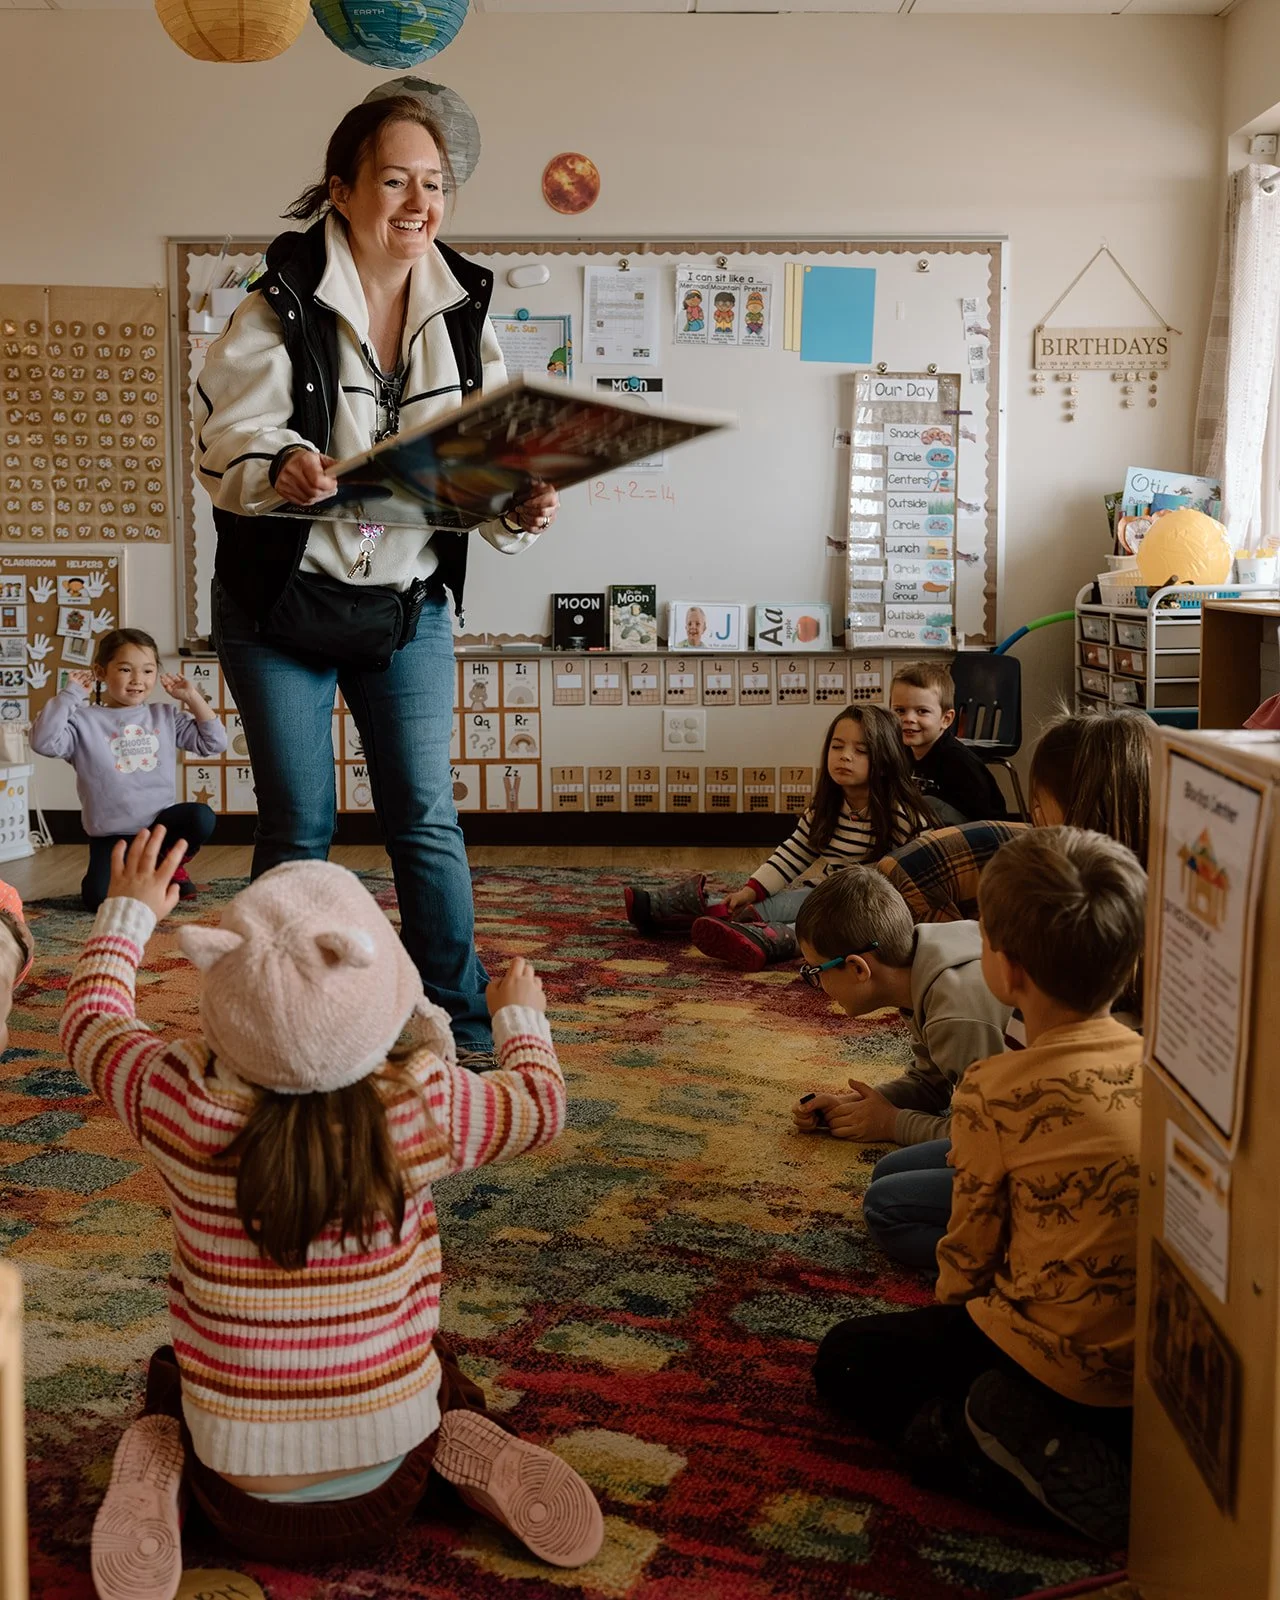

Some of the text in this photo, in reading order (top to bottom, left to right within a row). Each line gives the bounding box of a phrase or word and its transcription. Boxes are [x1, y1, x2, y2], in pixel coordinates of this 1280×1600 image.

[353, 8, 384, 16] EARTH
[688, 272, 692, 280] I
[716, 274, 726, 282] sit
[729, 275, 744, 283] like
[30, 324, 154, 336] 5 6 7 8 9 10
[505, 324, 537, 333] Mr. Sun
[7, 345, 18, 355] 14
[49, 345, 60, 355] 16
[73, 347, 84, 356] 17
[99, 348, 109, 357] 18
[119, 348, 131, 356] 19
[142, 348, 155, 359] 20
[1041, 337, 1168, 356] BIRTHDAYS
[8, 368, 156, 381] 24 25 26 27 28 29 30
[6, 391, 18, 400] 34
[52, 390, 65, 400] 36
[72, 391, 85, 400] 37
[95, 392, 108, 401] 38
[123, 392, 136, 401] 39
[144, 392, 157, 402] 40
[875, 383, 934, 400] Our Day
[28, 412, 41, 421] 45
[53, 412, 66, 421] 46
[73, 413, 87, 422] 47
[98, 414, 111, 422] 48
[120, 413, 133, 423] 49
[146, 415, 159, 424] 50
[890, 429, 920, 438] Snack
[7, 436, 20, 445] 54
[54, 435, 67, 444] 56
[75, 436, 88, 445] 57
[100, 436, 113, 445] 58
[122, 437, 135, 446] 59
[142, 437, 156, 446] 60
[894, 452, 922, 461] Circle
[6, 457, 161, 469] 64 65 66 67 68 69 70
[9, 478, 160, 491] 74 75 76 77 78 79 80
[888, 474, 930, 484] Centers
[7, 501, 164, 513] 84 85 86 87 88 89 90
[888, 498, 927, 508] Outside
[893, 520, 920, 530] Circle
[8, 526, 161, 539] 94 95 96 97 98 99 100
[886, 543, 920, 553] Lunch
[3, 559, 103, 569] CLASSROOM HELPERS
[893, 564, 921, 574] Circle
[895, 582, 917, 590] Small
[617, 593, 649, 604] Moon
[893, 593, 918, 602] Group
[557, 597, 600, 610] MOON
[887, 610, 926, 620] Outside
[715, 613, 731, 641] J
[758, 607, 784, 647] Aa
[888, 629, 915, 639] Circle
[193, 664, 527, 677] Aa Hh Ii
[565, 661, 871, 673] 0 1 2 3 4 5 6 7 8
[473, 715, 490, 728] Qq
[515, 714, 528, 725] Rr
[120, 737, 152, 748] CHOOSE
[197, 767, 210, 780] Ss
[236, 767, 250, 779] Tt
[505, 766, 519, 777] Zz
[561, 770, 804, 781] 11 12 13 14 15 16 17
